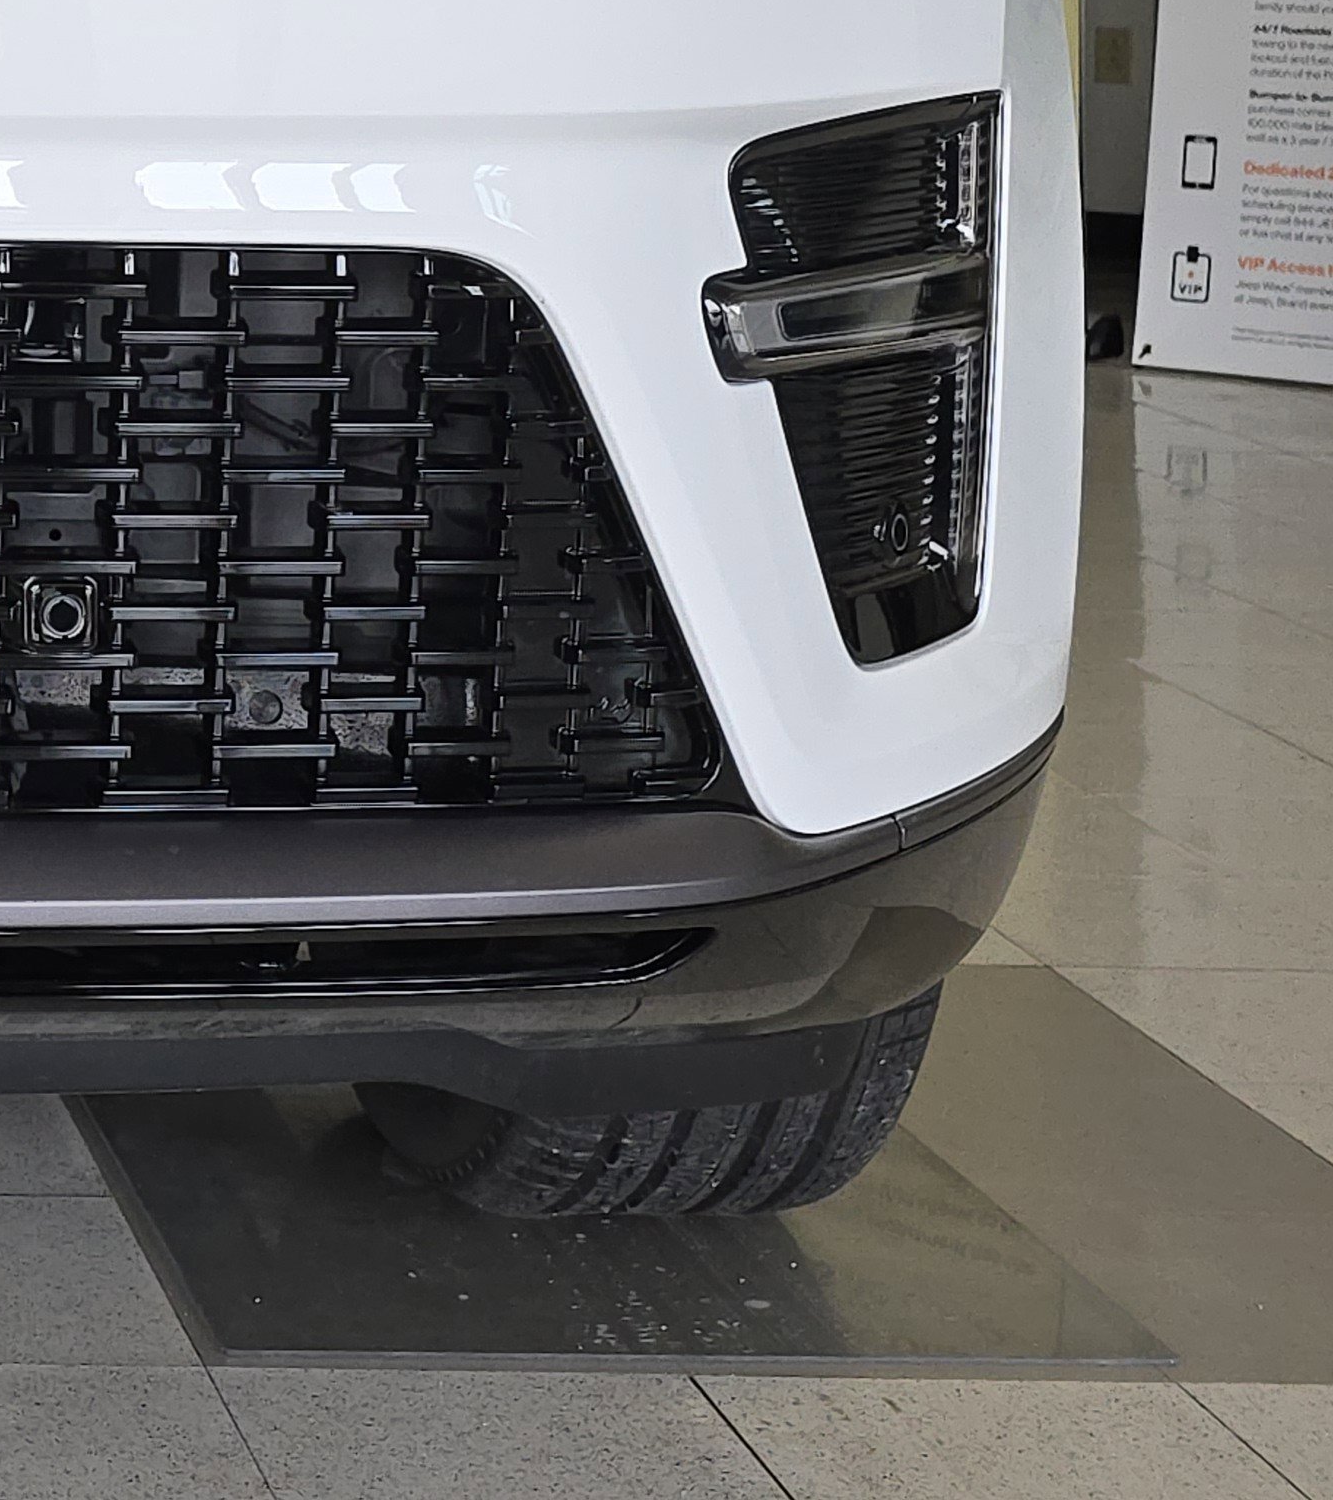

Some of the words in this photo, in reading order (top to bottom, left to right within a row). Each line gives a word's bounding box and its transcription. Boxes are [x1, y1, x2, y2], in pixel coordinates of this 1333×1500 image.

[1244, 161, 1325, 179] Dedicated
[1237, 256, 1265, 271] VIP
[1267, 258, 1326, 277] Access
